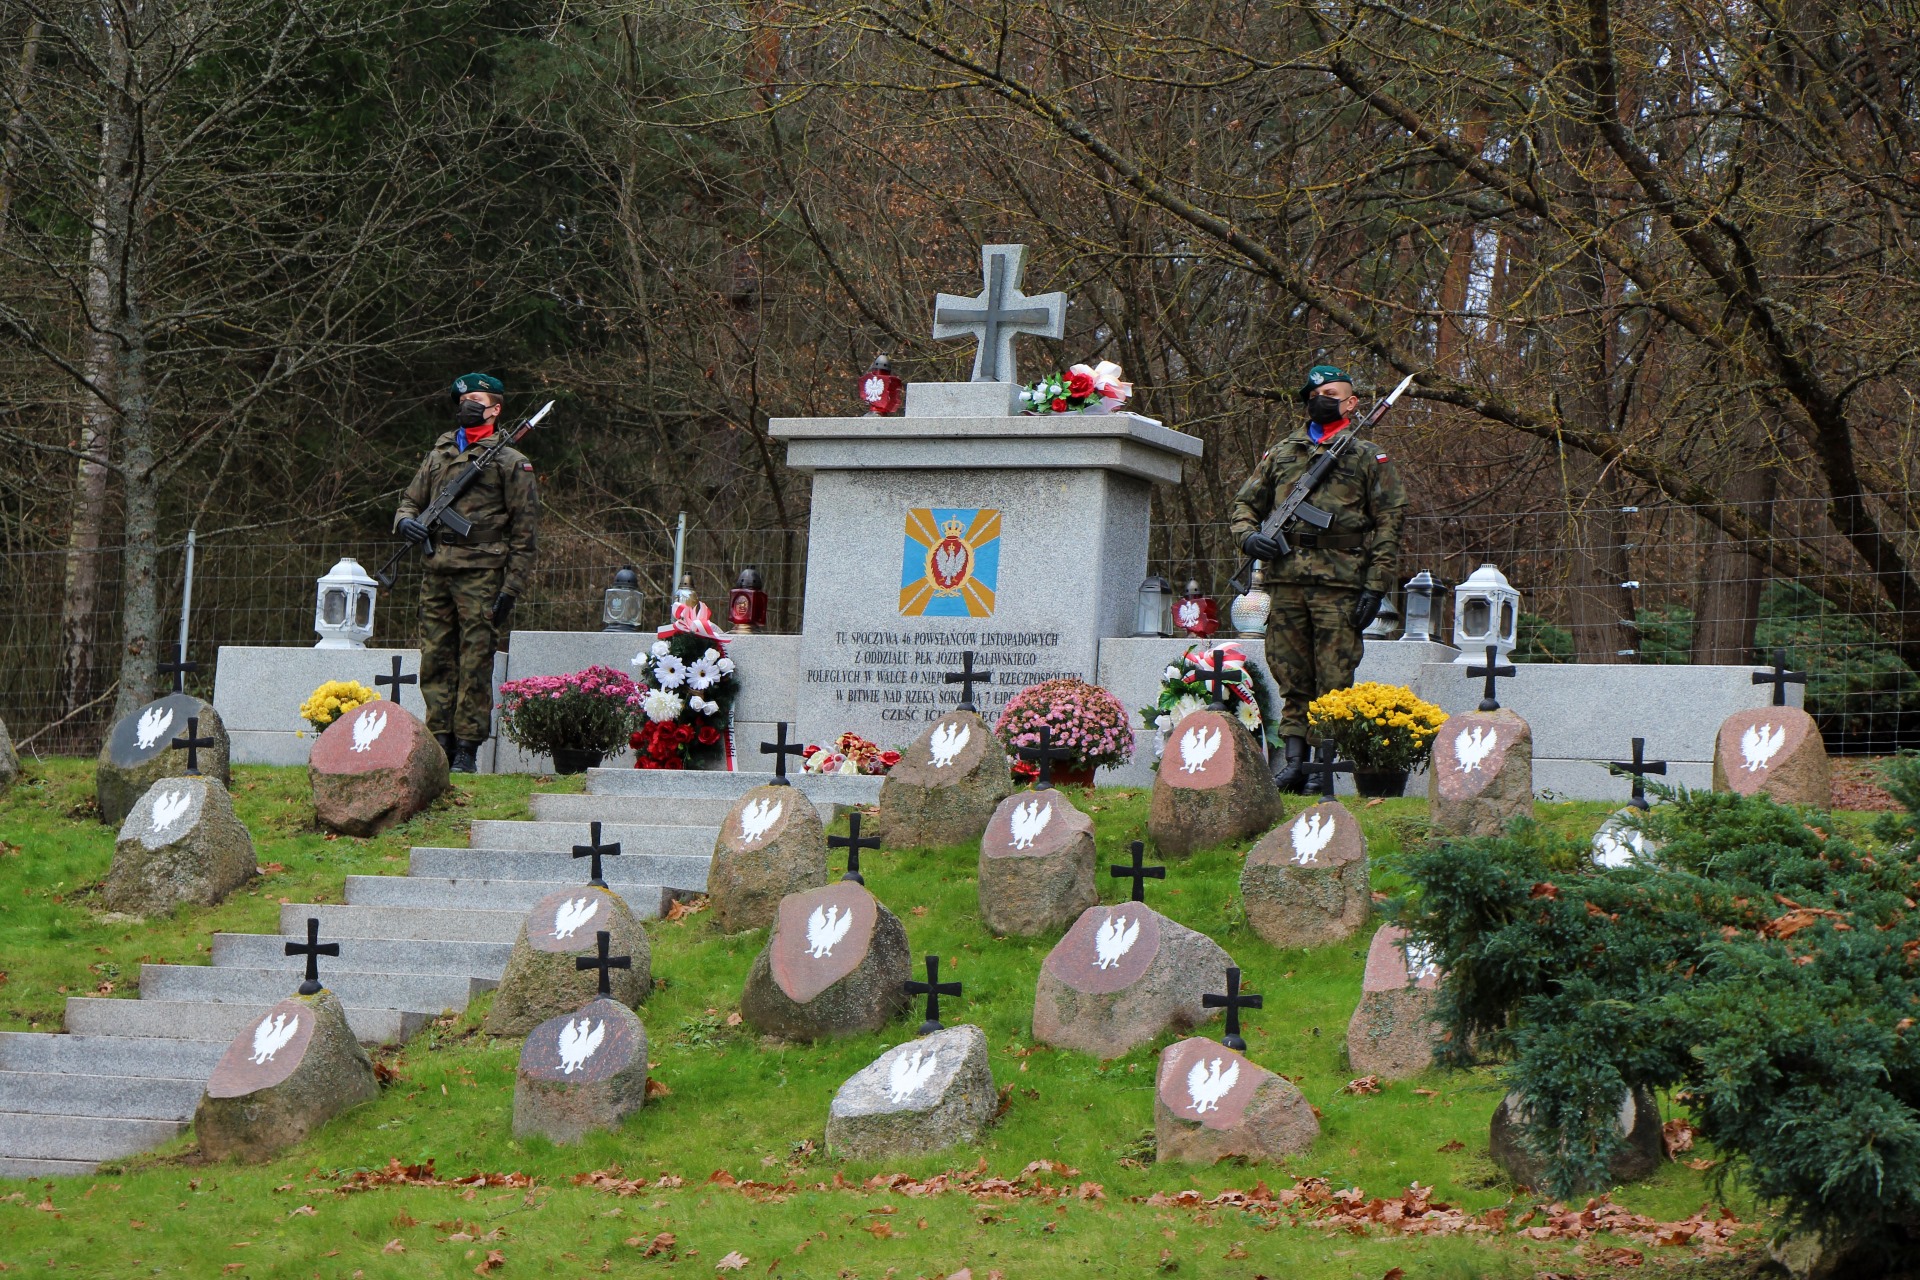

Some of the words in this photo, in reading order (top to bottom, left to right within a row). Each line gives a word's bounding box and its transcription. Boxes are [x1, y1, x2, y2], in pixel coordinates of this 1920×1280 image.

[836, 632, 849, 645] TU
[851, 632, 898, 645] SPOCZYWA
[901, 632, 911, 645] 46
[914, 629, 977, 646] POWSTAŃCÓW
[981, 632, 1058, 647] LISTOPADOWYCH
[854, 651, 862, 664] Z
[936, 648, 966, 665] JÓZEF
[973, 652, 1036, 666] ZALIWSKIEGO
[864, 670, 872, 683] W
[877, 670, 907, 684] WALCE
[910, 671, 918, 684] O
[836, 689, 843, 701] W
[848, 689, 880, 703] BITWIE
[883, 690, 902, 703] NAD
[994, 691, 1018, 704] LIPC
[881, 706, 920, 721] CZEŚĆ
